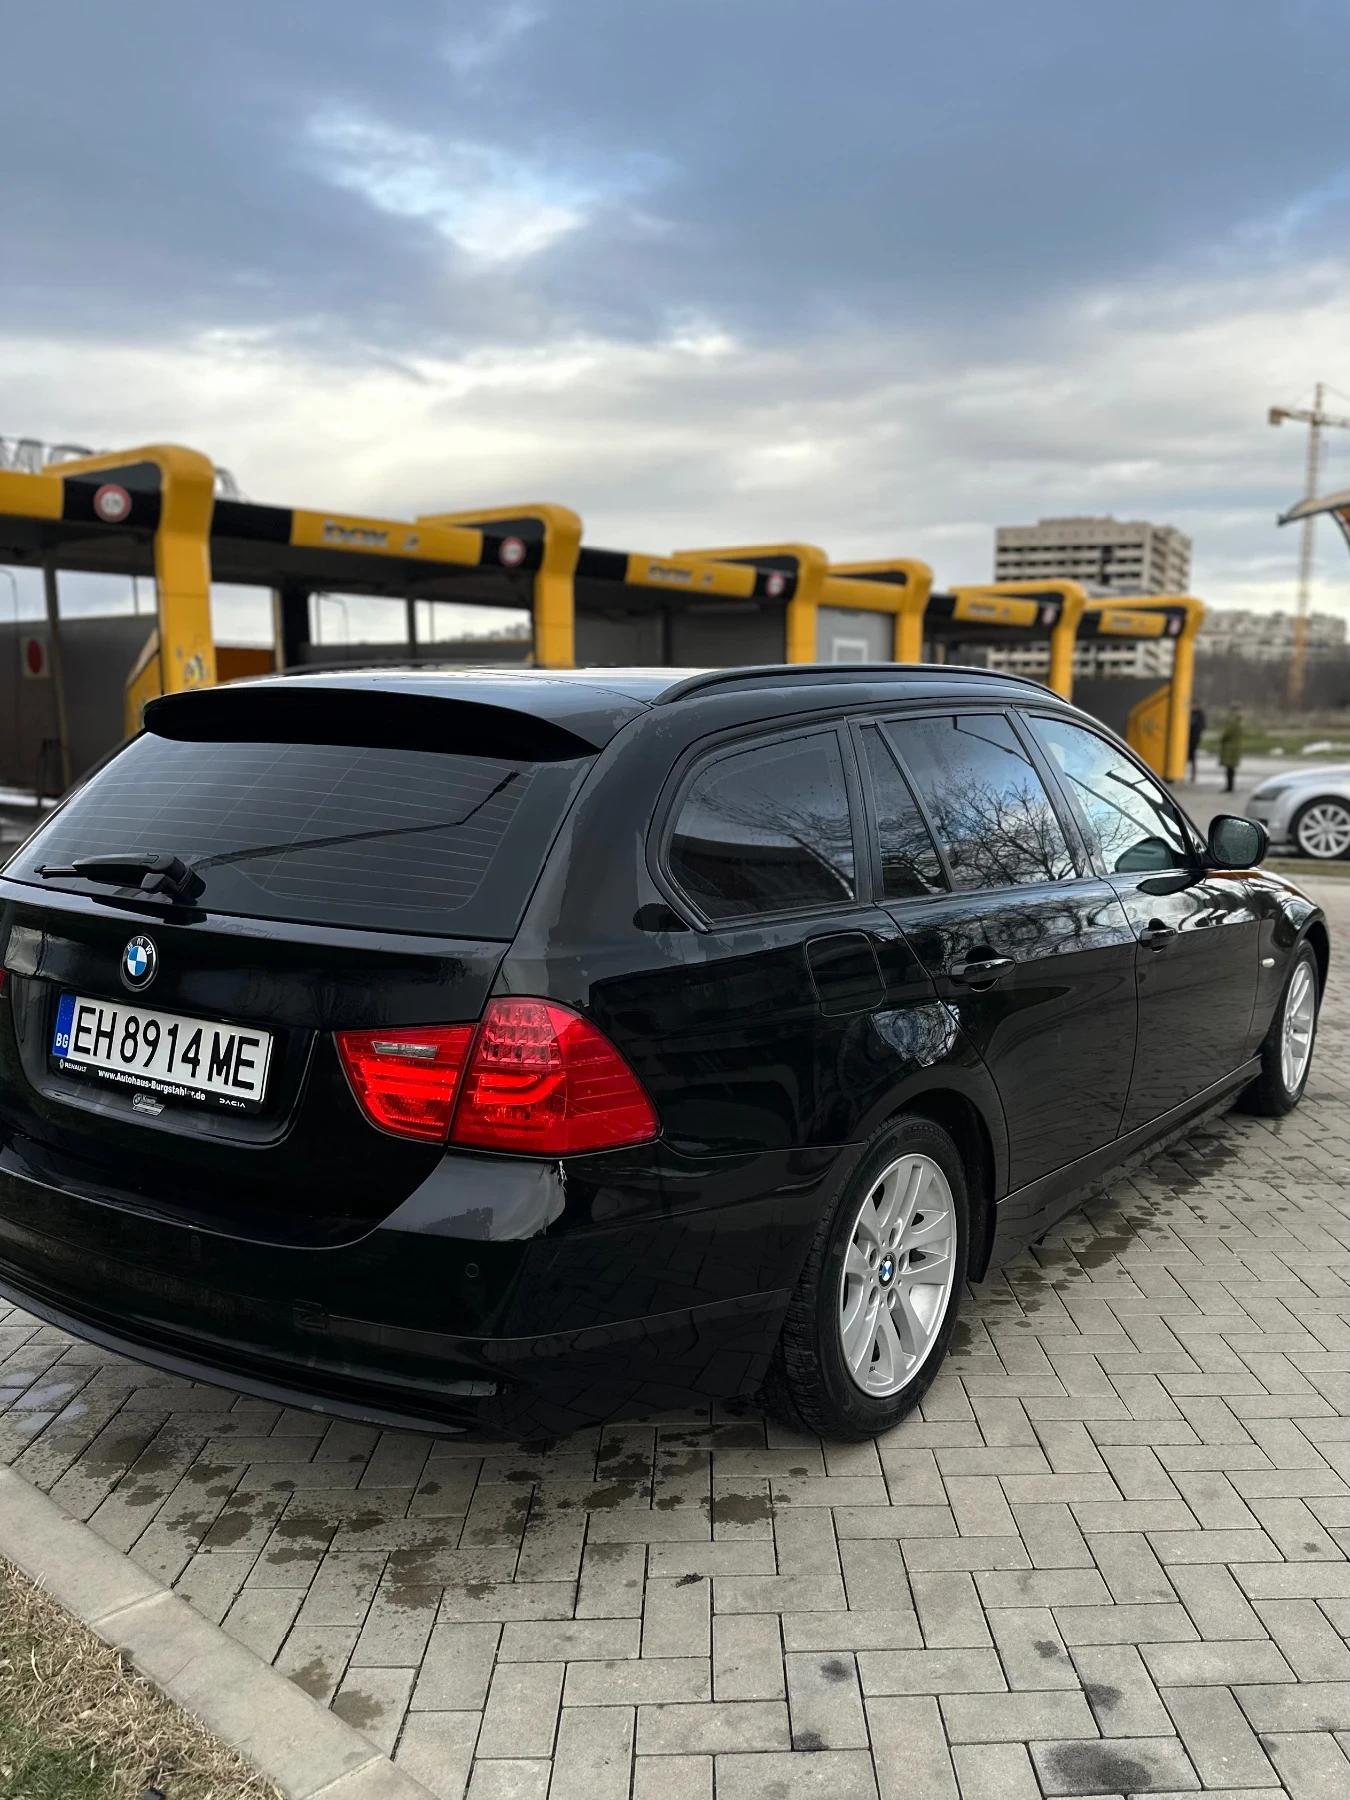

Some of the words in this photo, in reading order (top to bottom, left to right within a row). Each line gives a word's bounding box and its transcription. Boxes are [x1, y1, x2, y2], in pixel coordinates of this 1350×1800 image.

[127, 938, 153, 955] BMW
[56, 1033, 69, 1049] BG
[65, 1061, 87, 1073] RENAULT
[219, 1097, 246, 1109] DACIA
